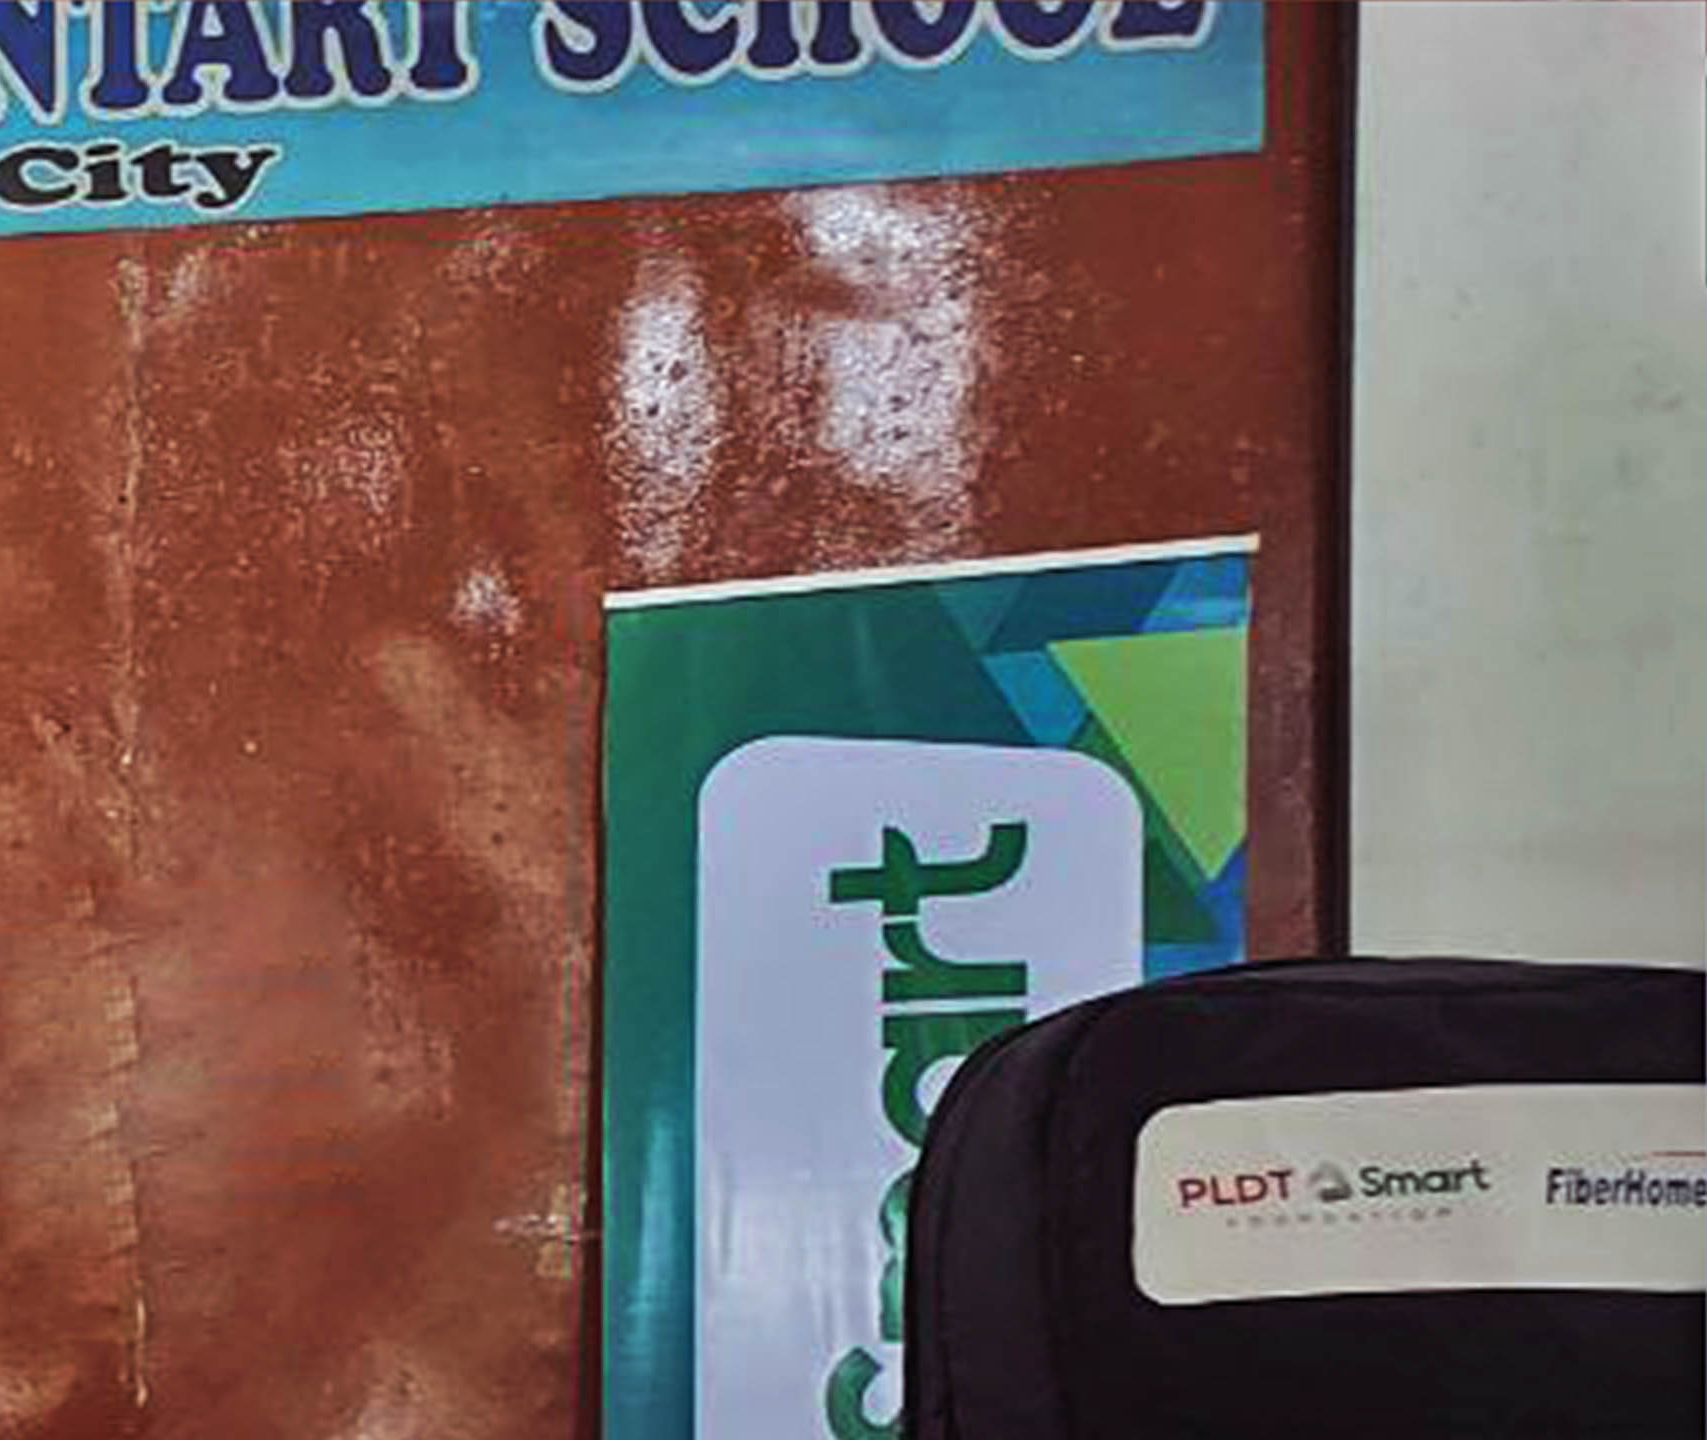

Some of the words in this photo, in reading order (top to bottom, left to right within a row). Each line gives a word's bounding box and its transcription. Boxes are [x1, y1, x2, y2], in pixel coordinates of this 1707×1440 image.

[1177, 1169, 1293, 1208] PLDT
[1358, 1160, 1491, 1197] Smart
[1545, 1166, 1707, 1207] FiberHome
